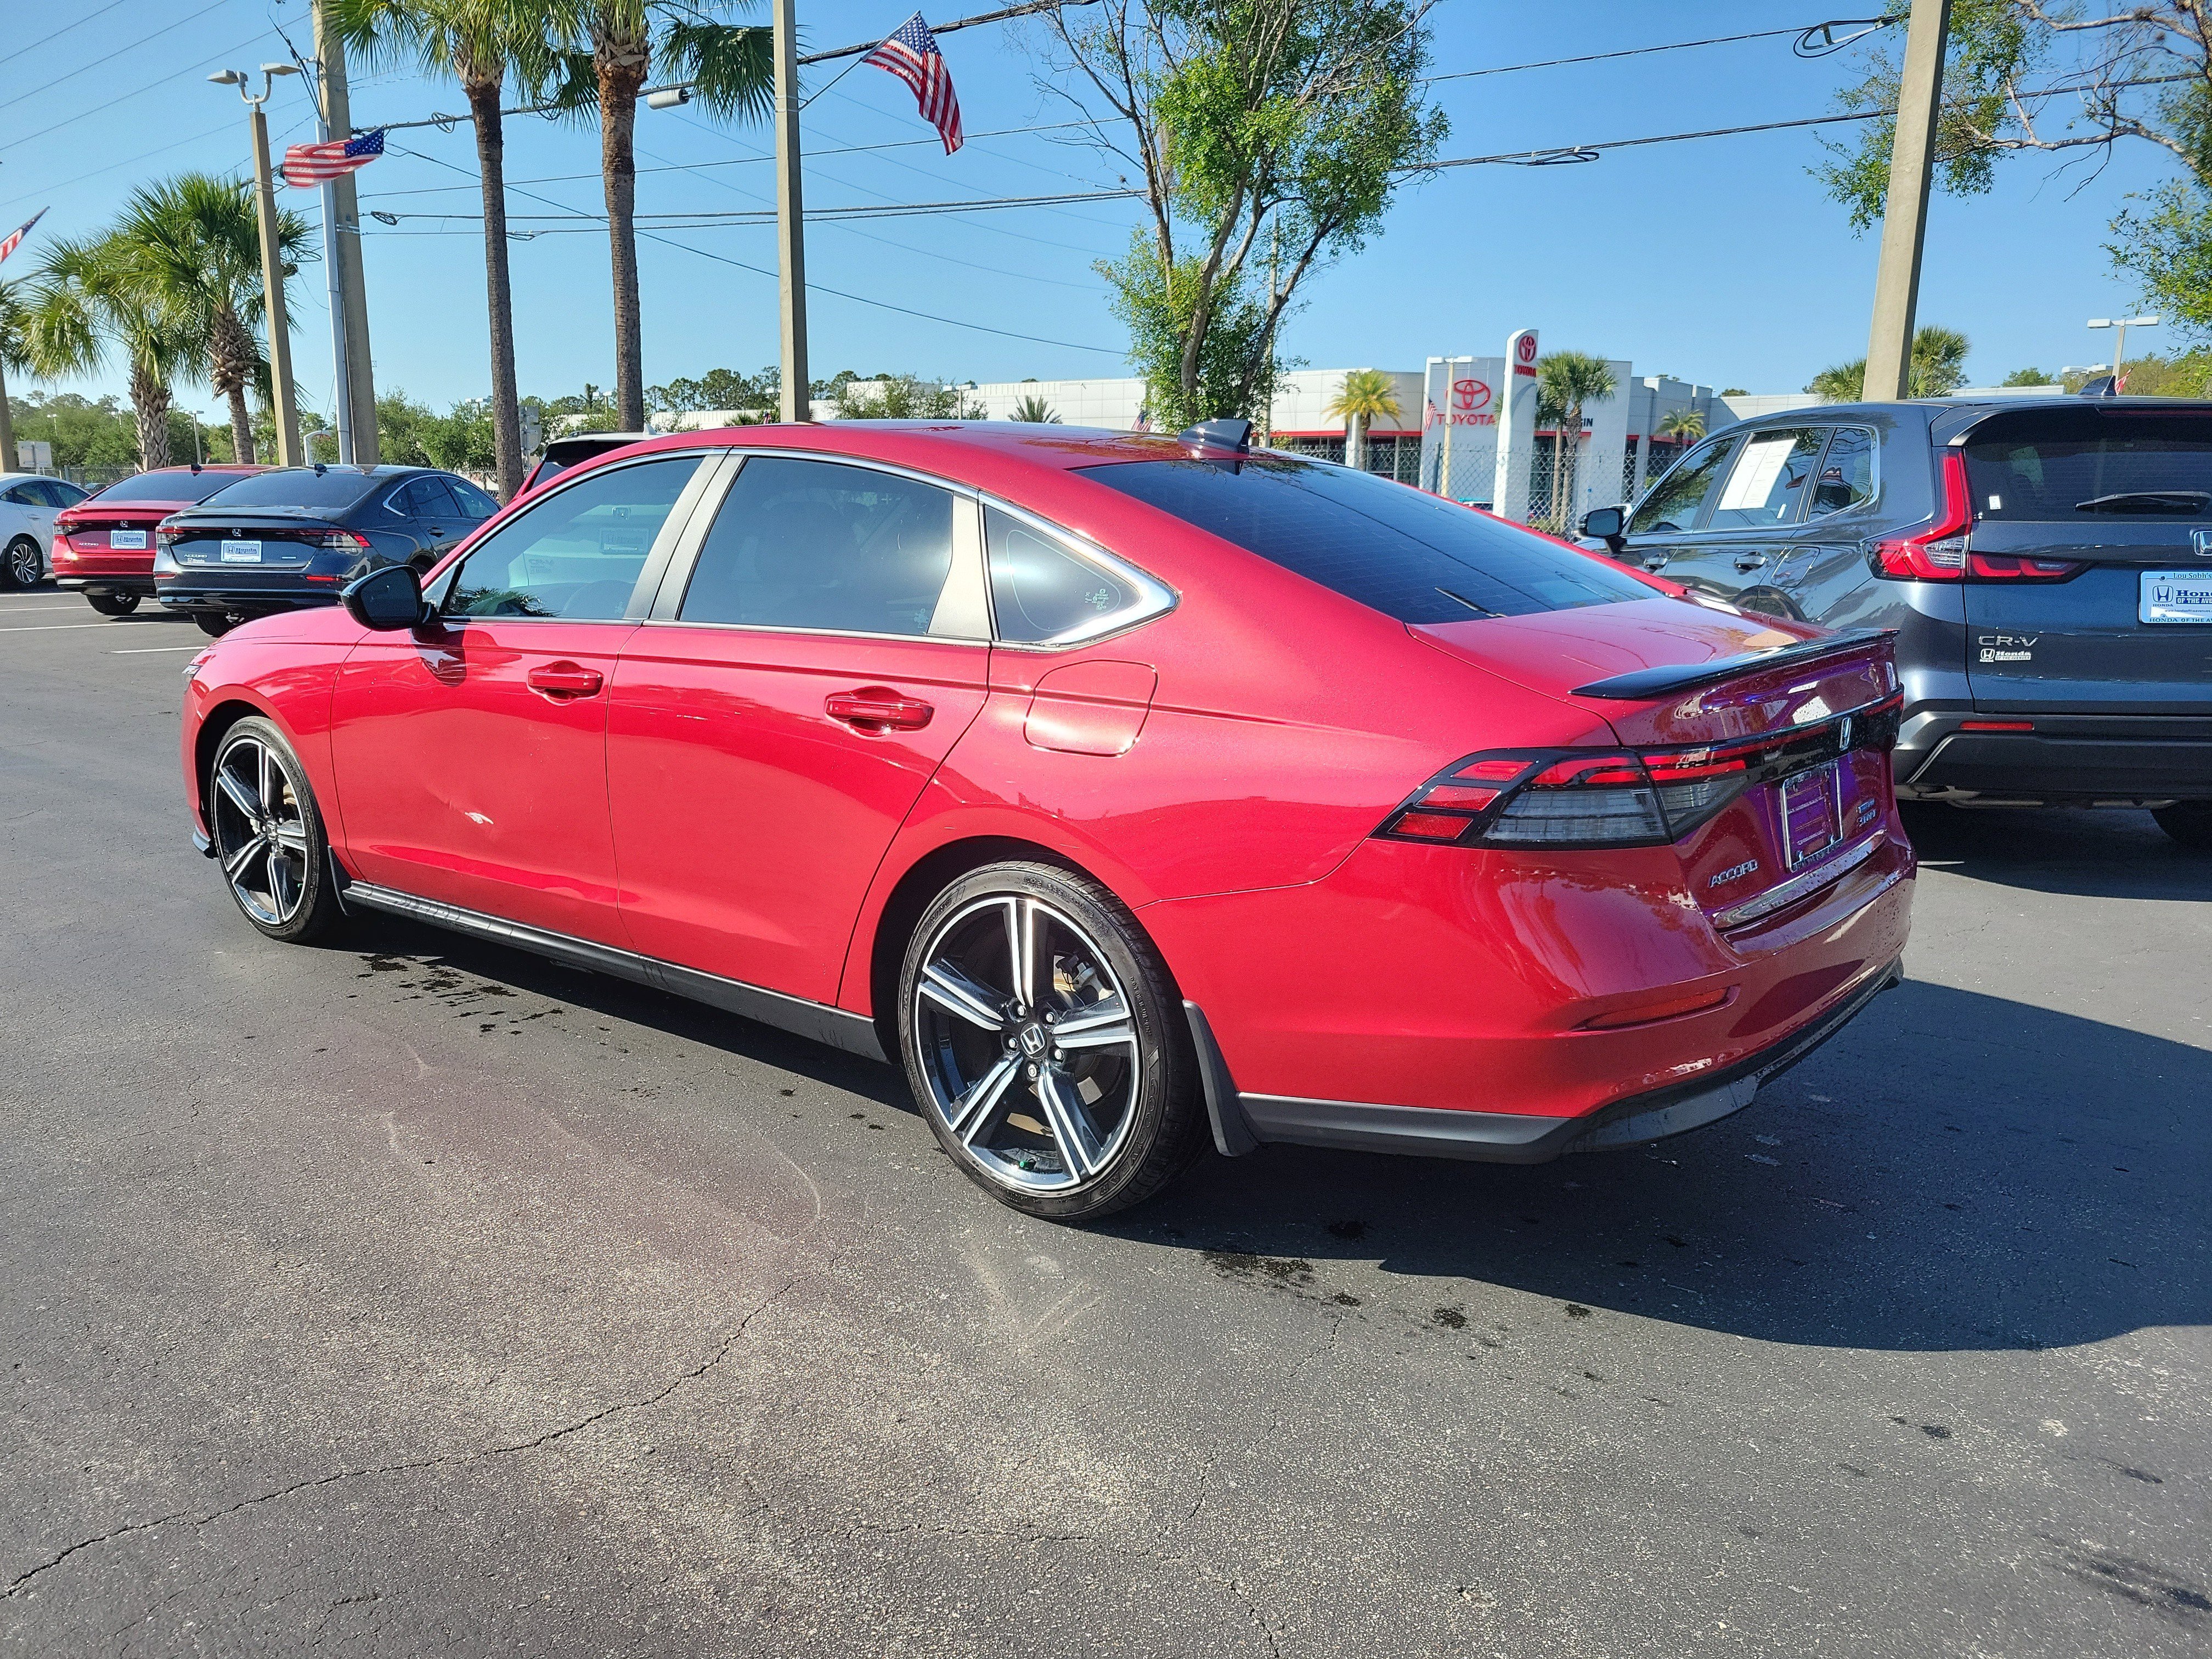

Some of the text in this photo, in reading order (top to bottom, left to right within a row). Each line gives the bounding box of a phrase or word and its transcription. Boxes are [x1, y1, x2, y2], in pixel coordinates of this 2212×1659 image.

[1514, 364, 1537, 378] TOYOTA
[1978, 635, 2039, 647] CR-V
[1707, 859, 1758, 888] ACCORD
[1099, 1077, 1159, 1195] GOODYEAR
